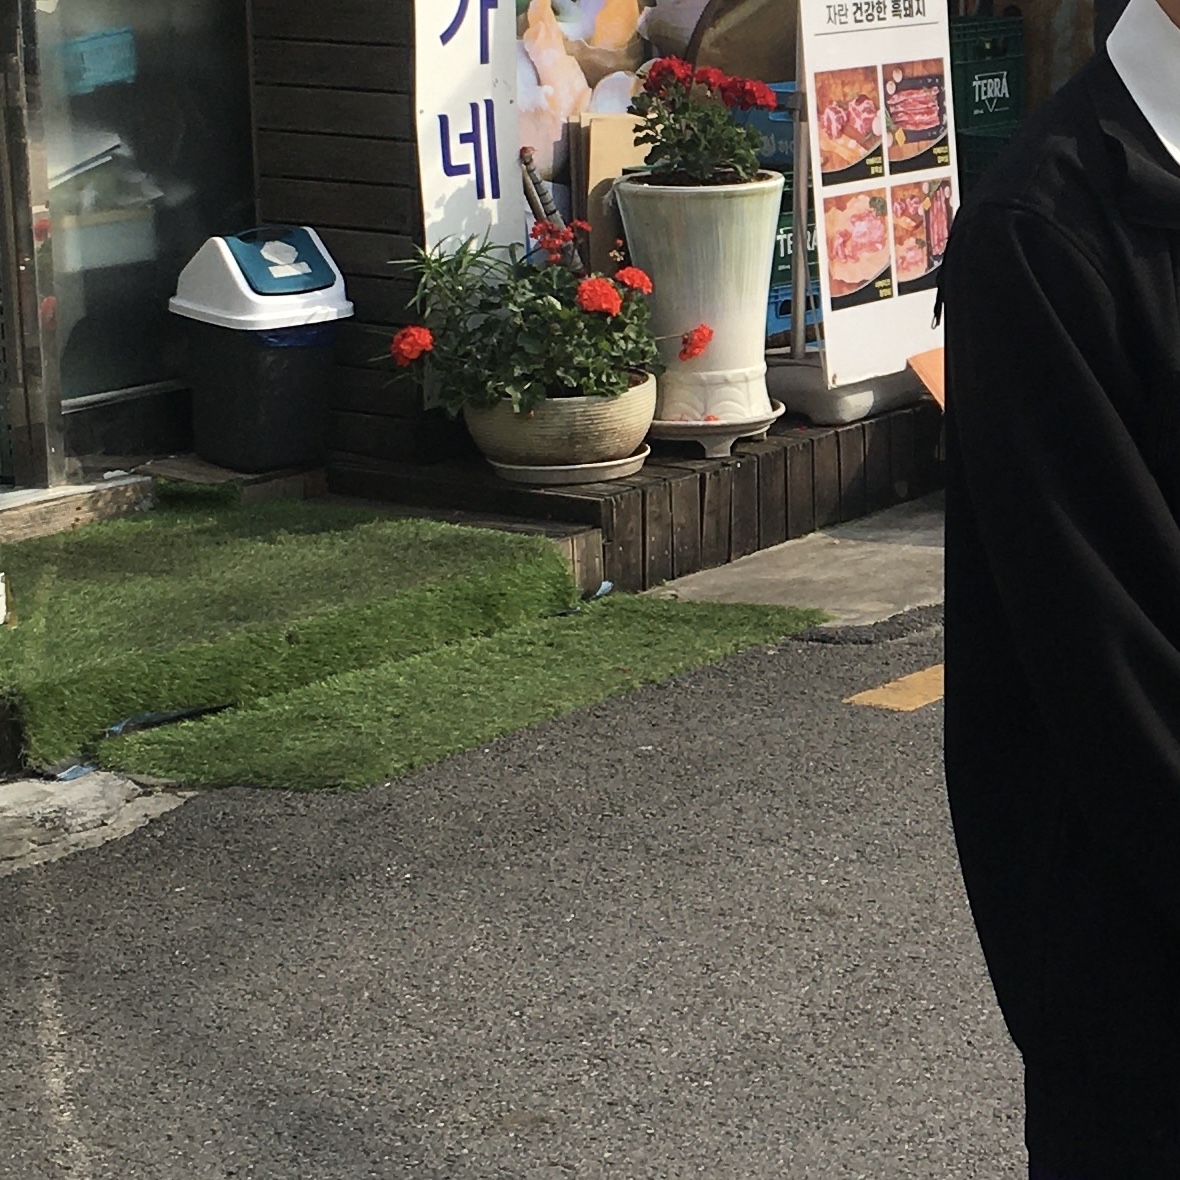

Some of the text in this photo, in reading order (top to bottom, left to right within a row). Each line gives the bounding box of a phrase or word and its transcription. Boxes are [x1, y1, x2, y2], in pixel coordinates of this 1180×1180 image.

[852, 1, 887, 24] 건강한
[972, 77, 1010, 103] TERRA
[776, 229, 818, 257] TEA
